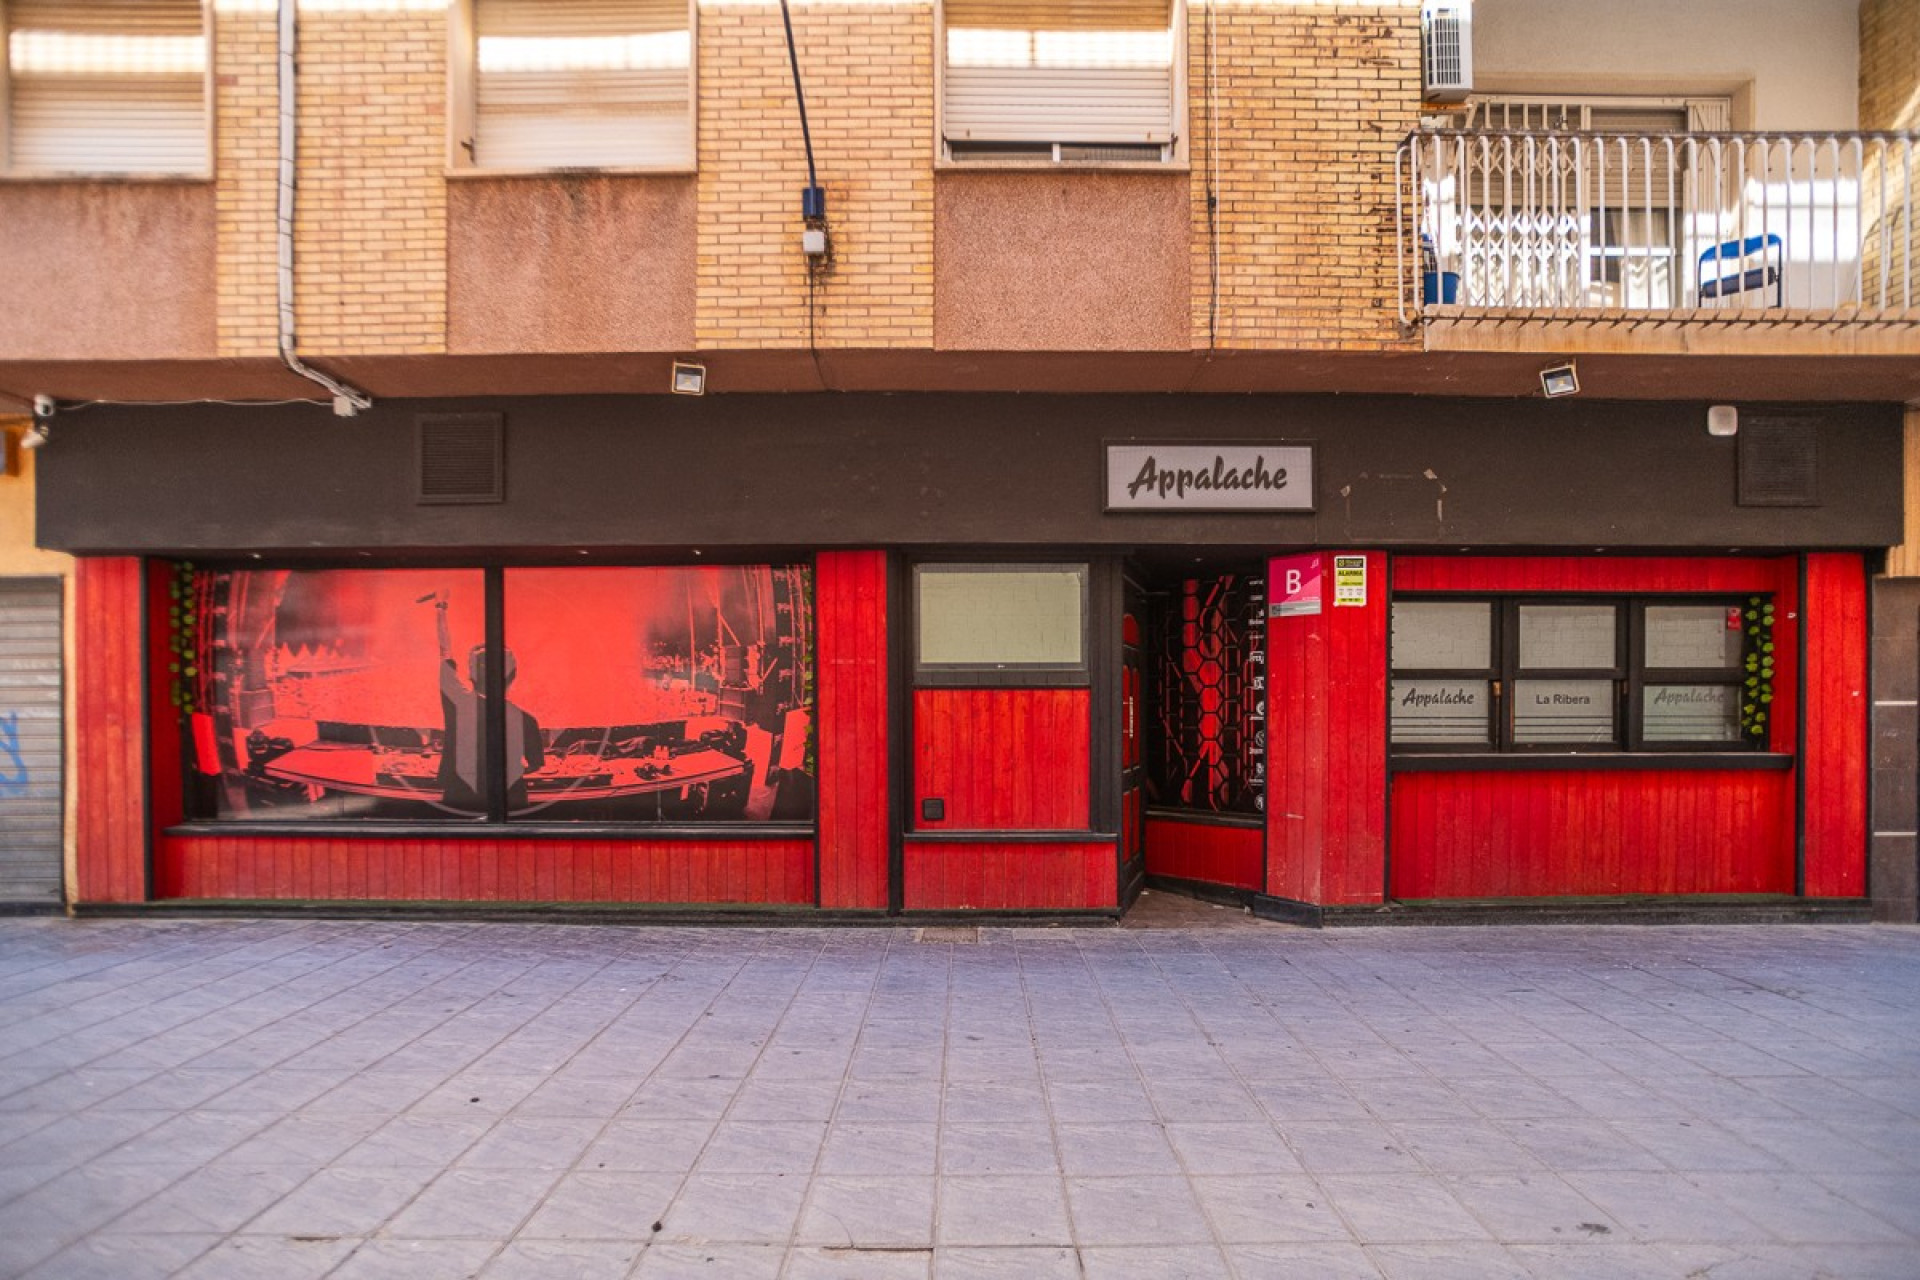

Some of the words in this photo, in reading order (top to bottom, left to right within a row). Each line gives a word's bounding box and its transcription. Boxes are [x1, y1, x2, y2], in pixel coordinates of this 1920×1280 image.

[1127, 455, 1288, 500] Appalache
[1286, 569, 1302, 594] B
[1402, 687, 1475, 708] Appalache
[1536, 694, 1550, 705] La
[1553, 694, 1590, 705] Ribera
[1654, 687, 1726, 706] Appalache
